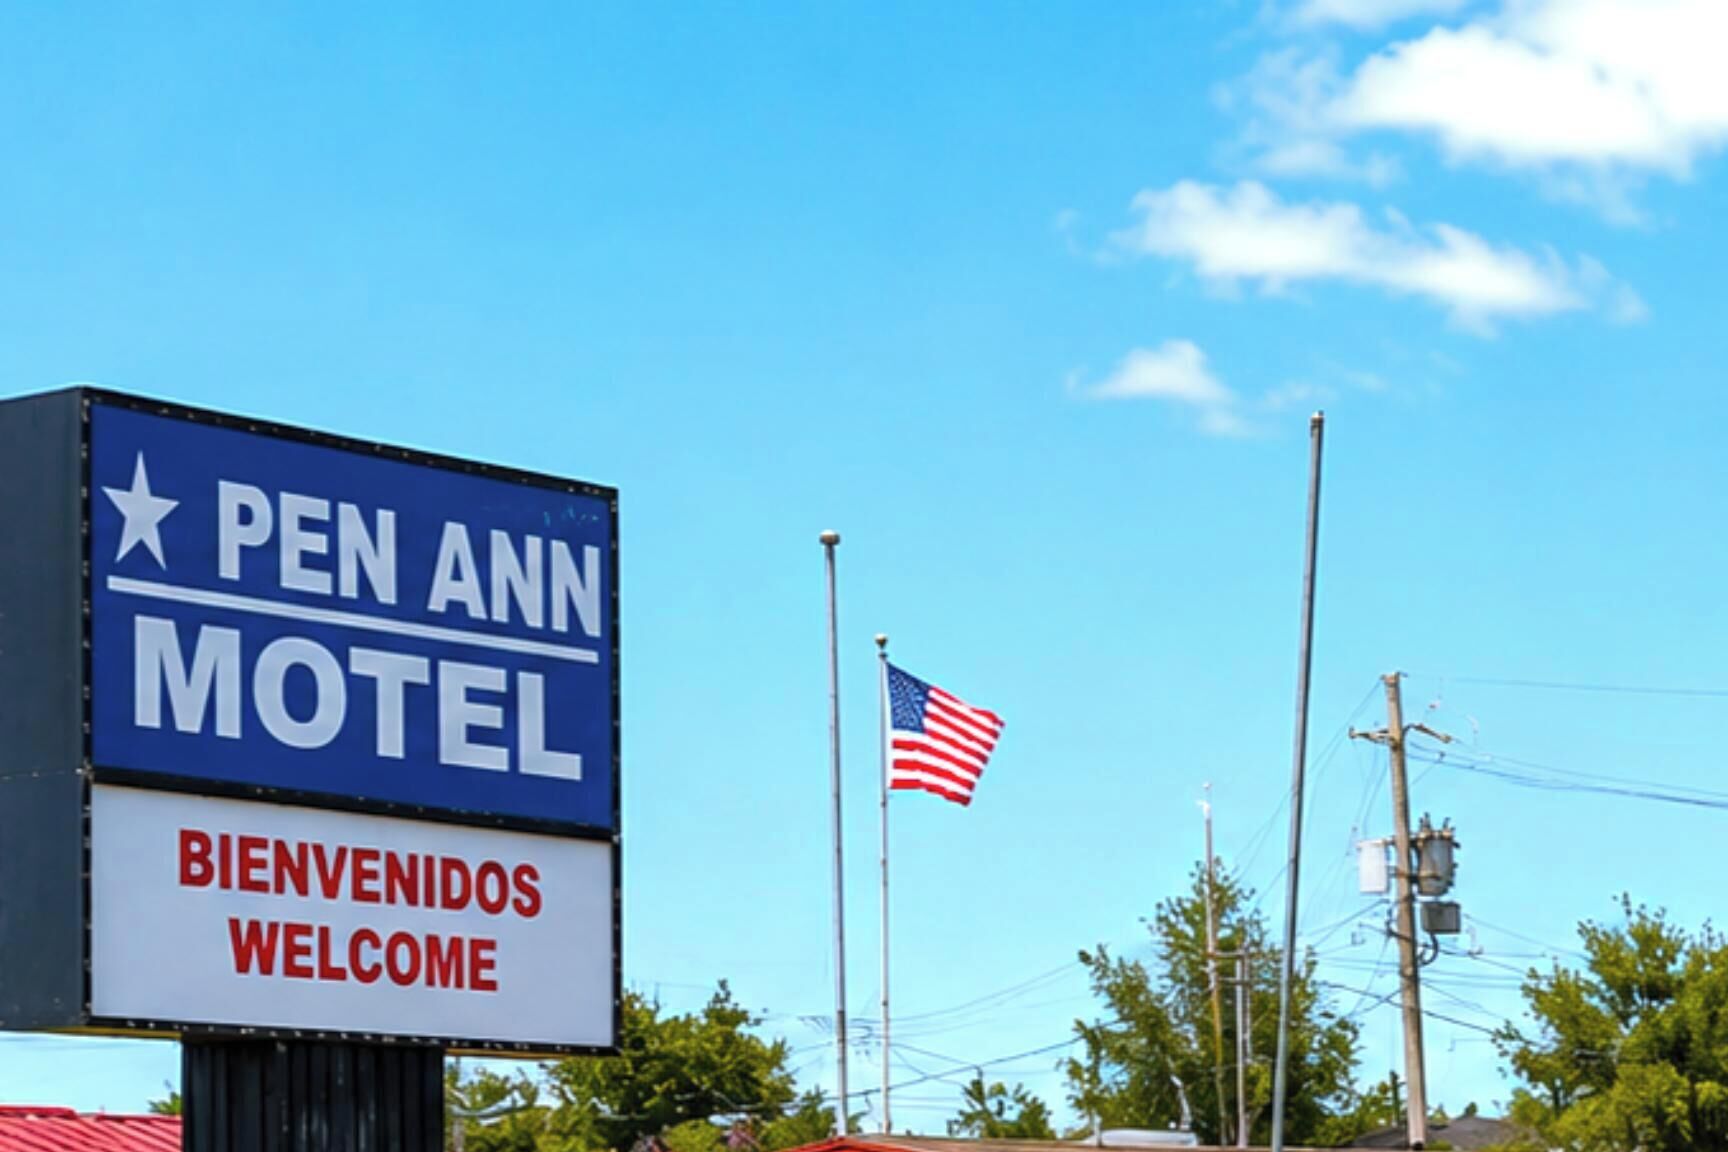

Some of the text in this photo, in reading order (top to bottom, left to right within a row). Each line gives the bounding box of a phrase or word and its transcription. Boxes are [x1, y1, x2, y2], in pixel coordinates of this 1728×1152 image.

[218, 480, 601, 638] PEN ANN
[134, 614, 582, 781] MOTEL
[178, 828, 542, 918] BIENVENIDOS
[228, 918, 499, 992] WELCOME
